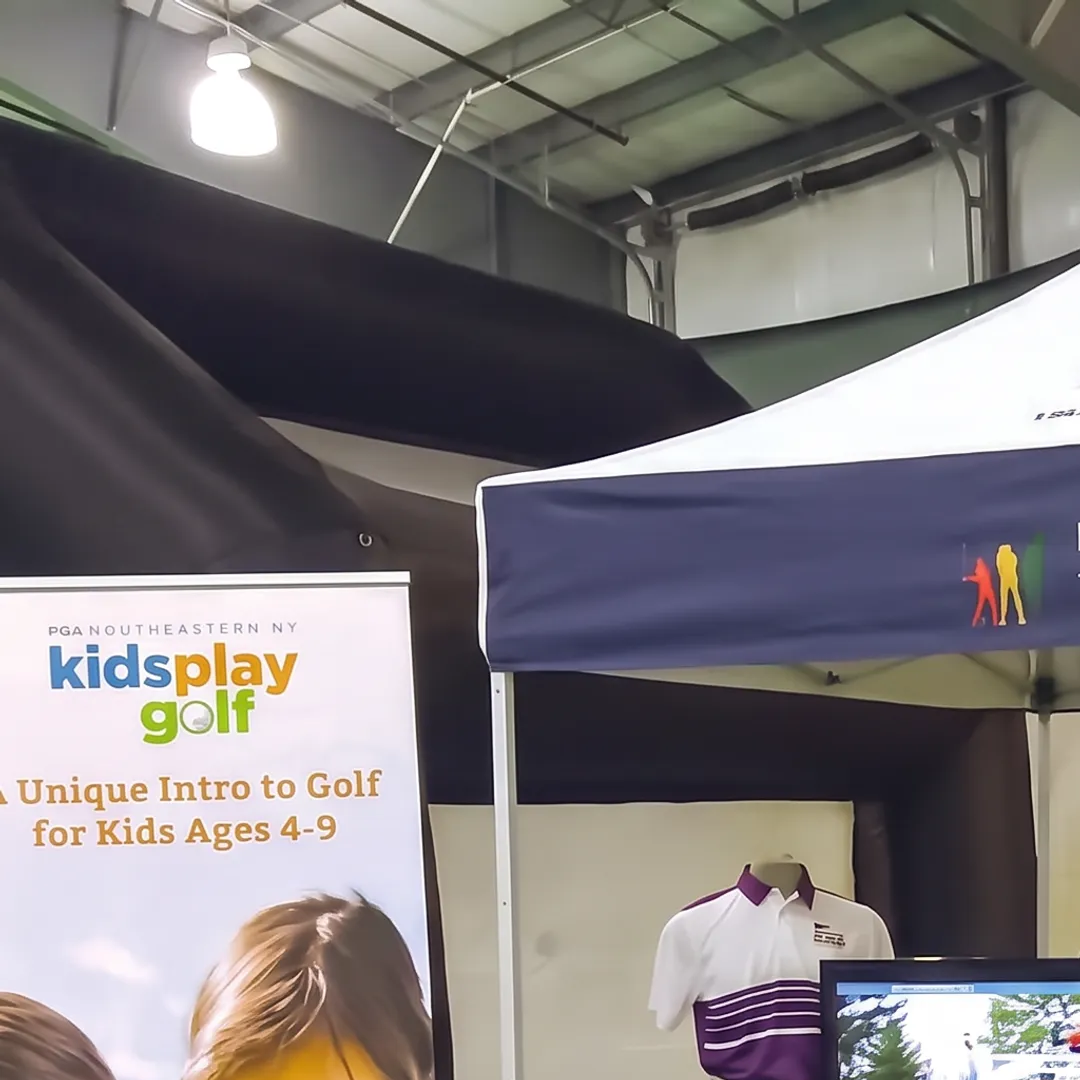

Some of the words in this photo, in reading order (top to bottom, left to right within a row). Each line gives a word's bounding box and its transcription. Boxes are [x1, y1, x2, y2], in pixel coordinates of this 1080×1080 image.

[48, 626, 83, 636] PGA
[272, 622, 297, 634] NY
[49, 642, 298, 696] kidsplay
[140, 689, 255, 745] golf
[16, 776, 148, 811] Unique
[160, 775, 251, 802] Intro
[260, 774, 296, 801] to
[307, 770, 383, 799] Golf
[32, 819, 86, 848] for
[97, 818, 175, 846] Kids
[184, 817, 270, 851] Ages
[280, 815, 337, 841] 4-9
